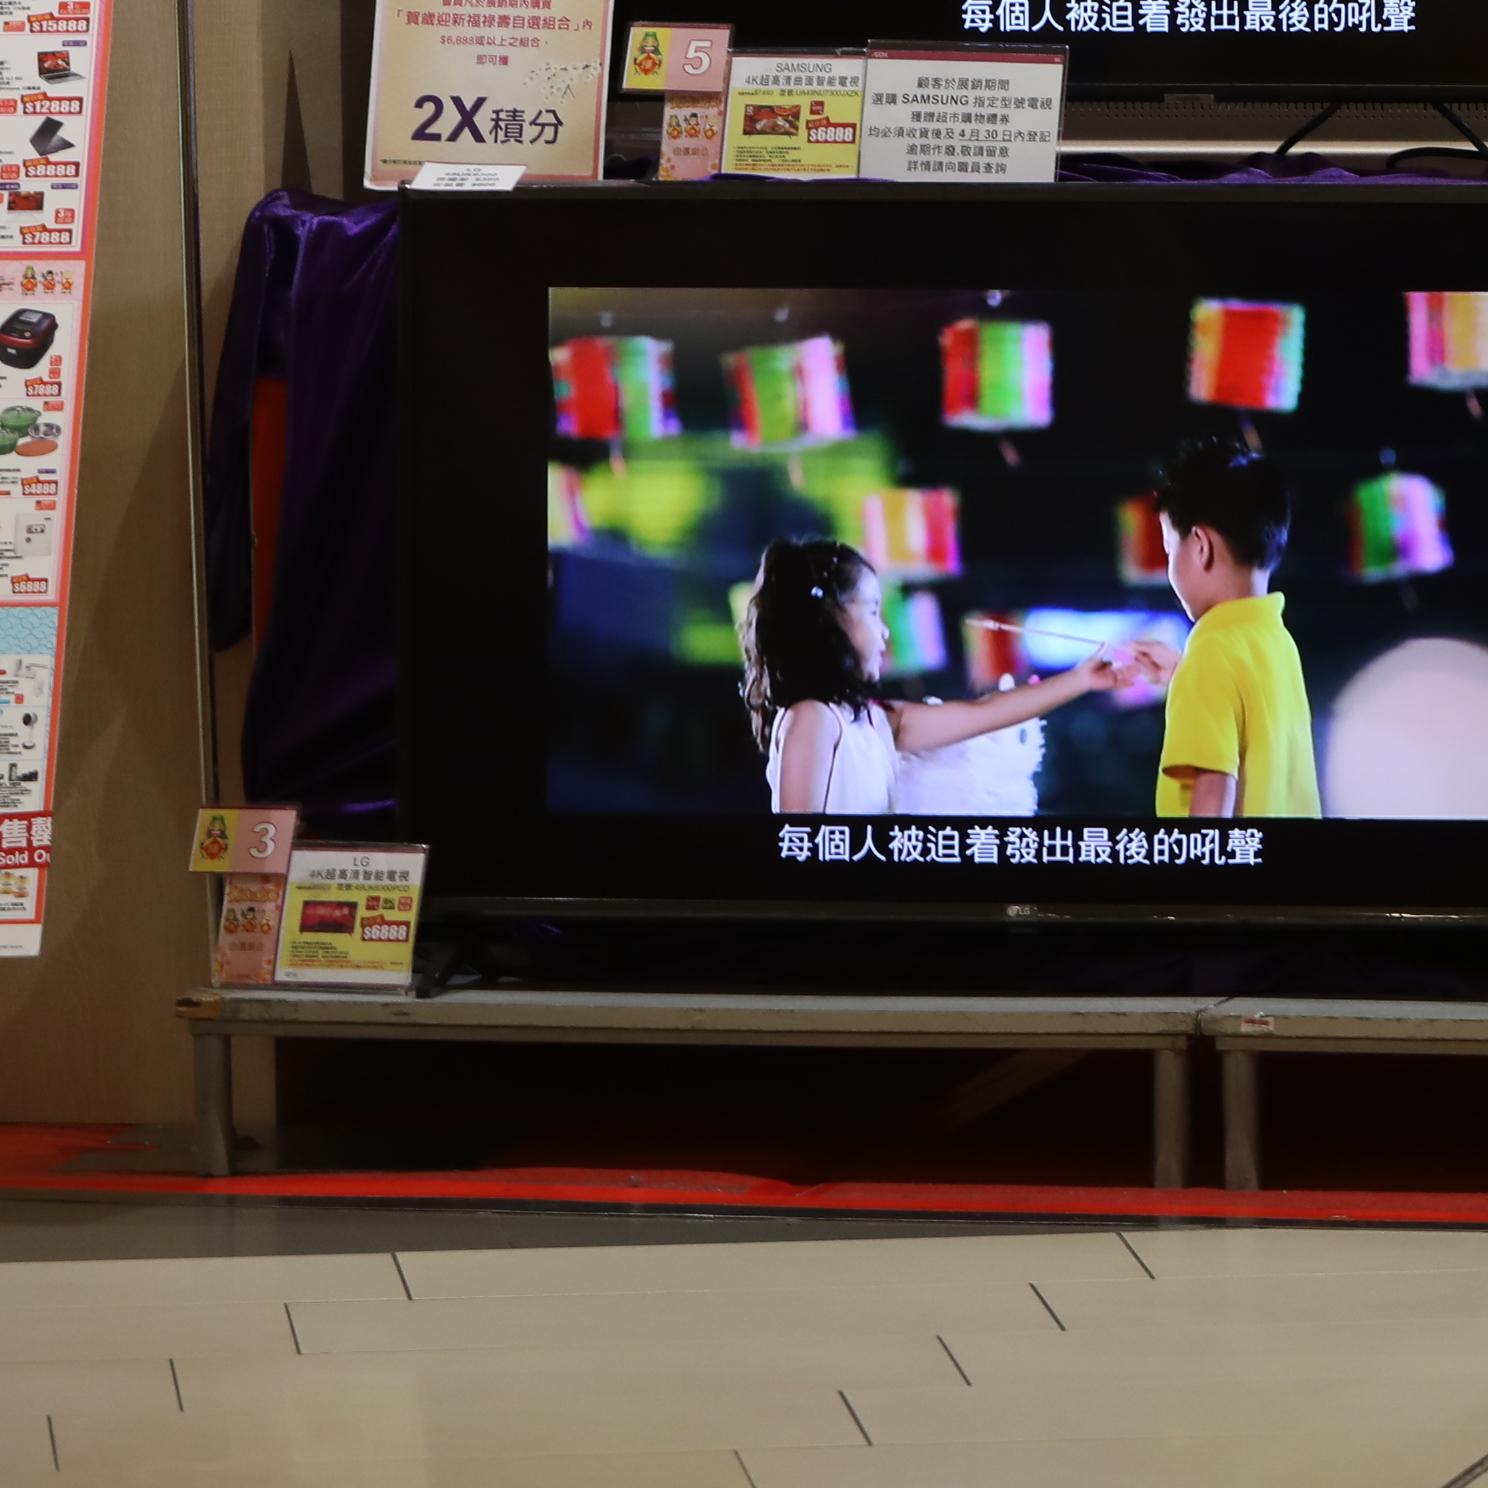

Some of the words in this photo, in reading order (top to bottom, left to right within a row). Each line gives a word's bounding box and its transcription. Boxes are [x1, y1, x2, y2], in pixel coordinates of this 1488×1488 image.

[31, 19, 88, 32] $15888
[683, 39, 712, 75] 5
[776, 62, 832, 73] SAMSUNG
[917, 76, 1010, 91] 顧客於展銷期間
[25, 100, 80, 113] $12888
[872, 93, 898, 105] 選購
[901, 93, 969, 106] SAMSUNG
[973, 96, 1053, 110] 指定型號電視
[809, 127, 853, 142] $6888
[959, 129, 966, 138] 4
[969, 129, 980, 140] 月
[984, 129, 998, 139] 30
[249, 822, 277, 858] 3
[778, 823, 1264, 865] 每個人被迫着發出最後的吼聲
[353, 856, 370, 867] LG
[363, 925, 407, 941] $6888
